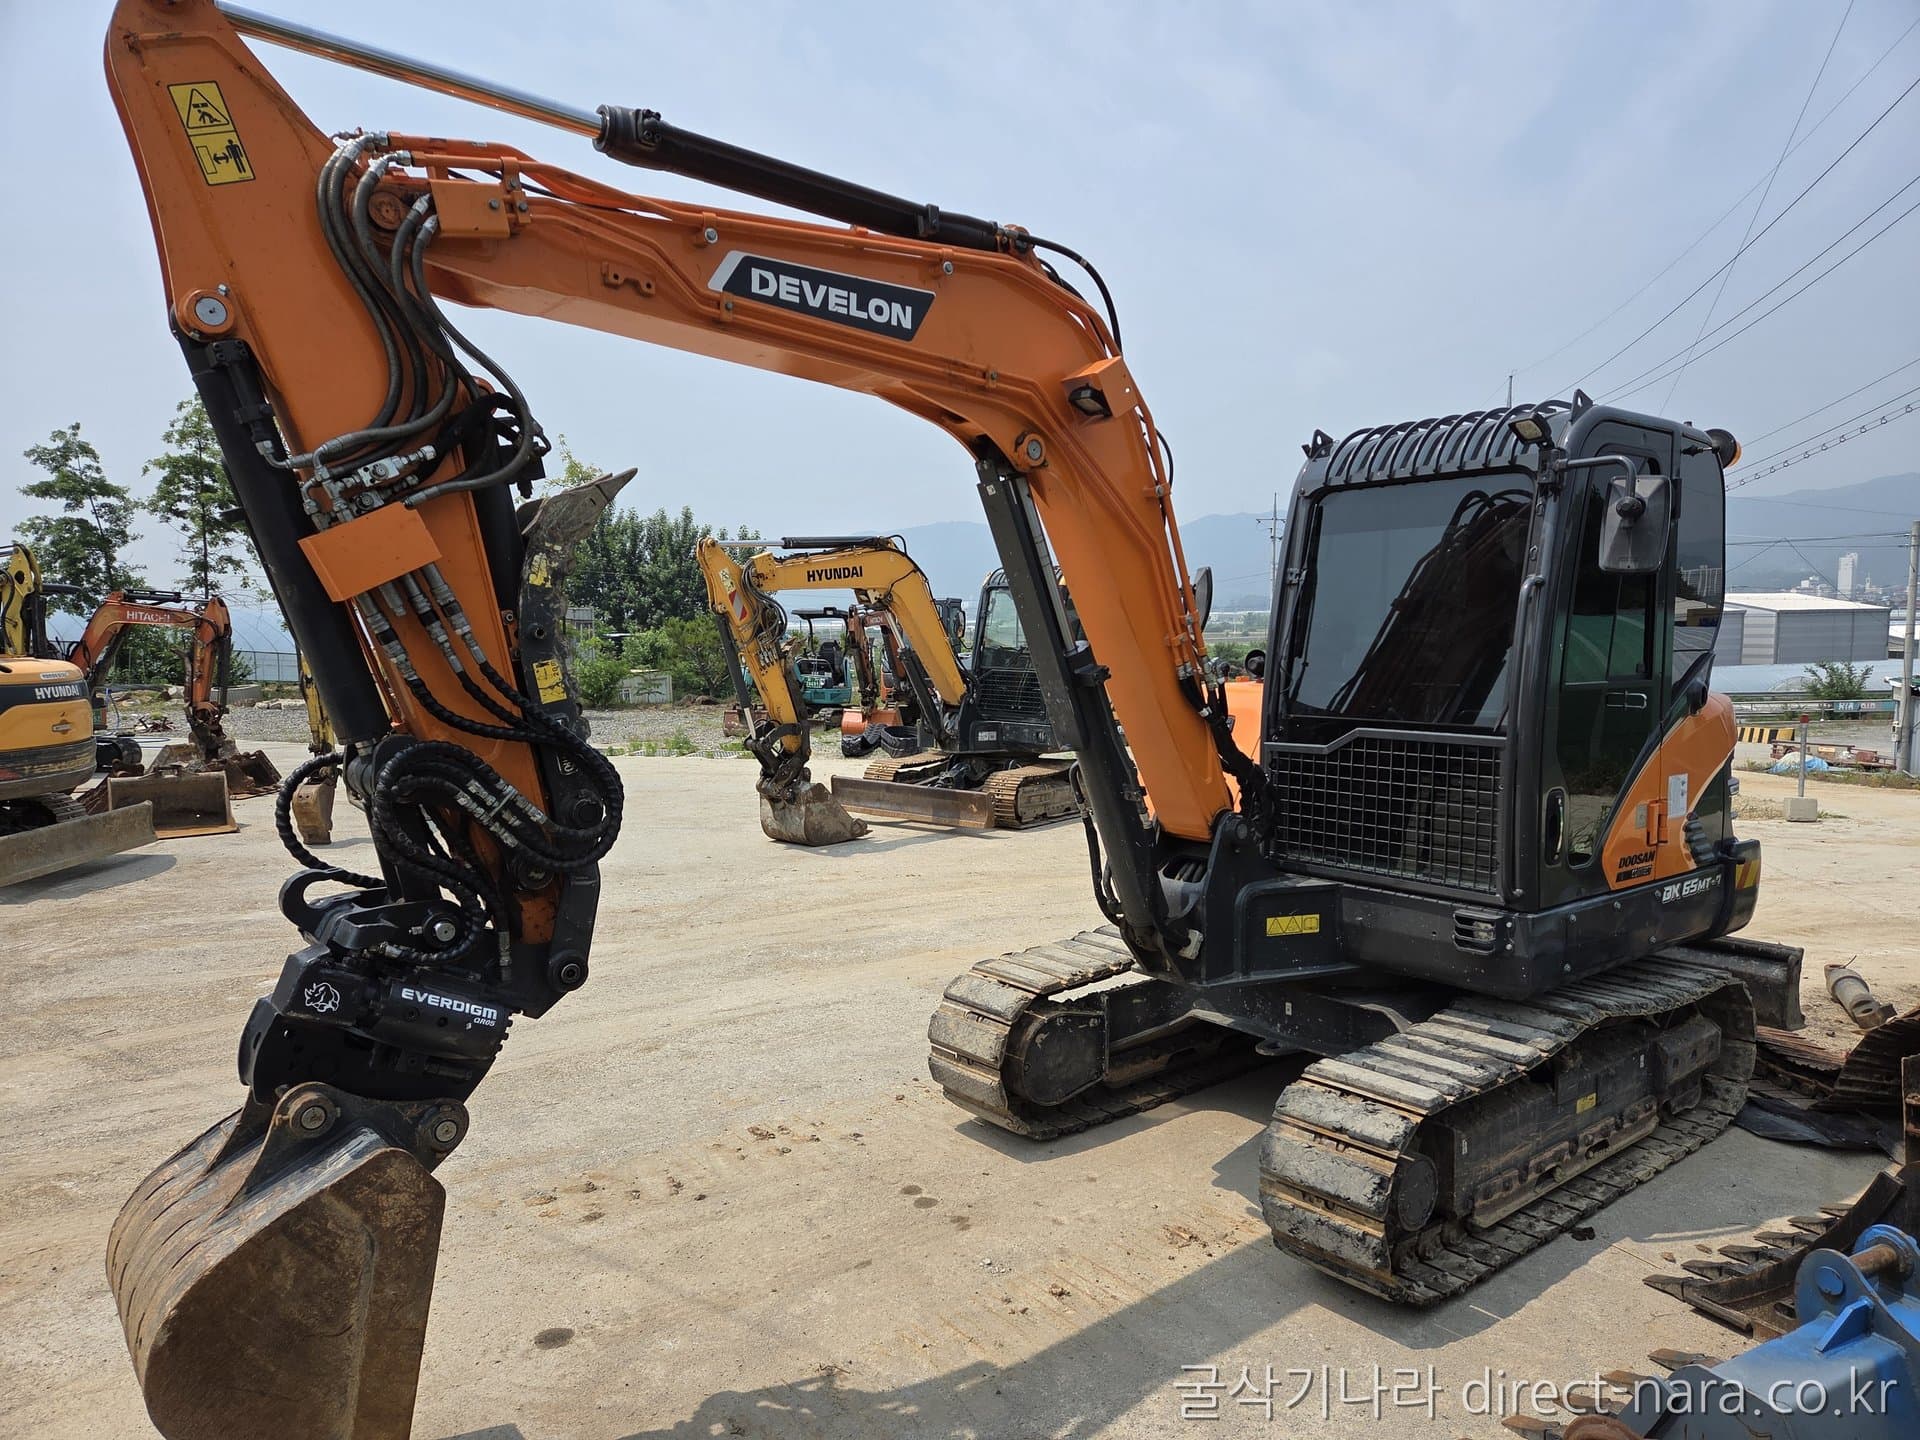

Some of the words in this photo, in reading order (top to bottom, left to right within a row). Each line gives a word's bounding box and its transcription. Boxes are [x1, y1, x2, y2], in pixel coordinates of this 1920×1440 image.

[751, 267, 912, 330] DEVELON
[806, 565, 863, 582] HYUNDAI
[34, 684, 80, 700] HYUNDAI
[1618, 850, 1656, 869] DOOSAN
[401, 987, 498, 1020] EVERDIGM
